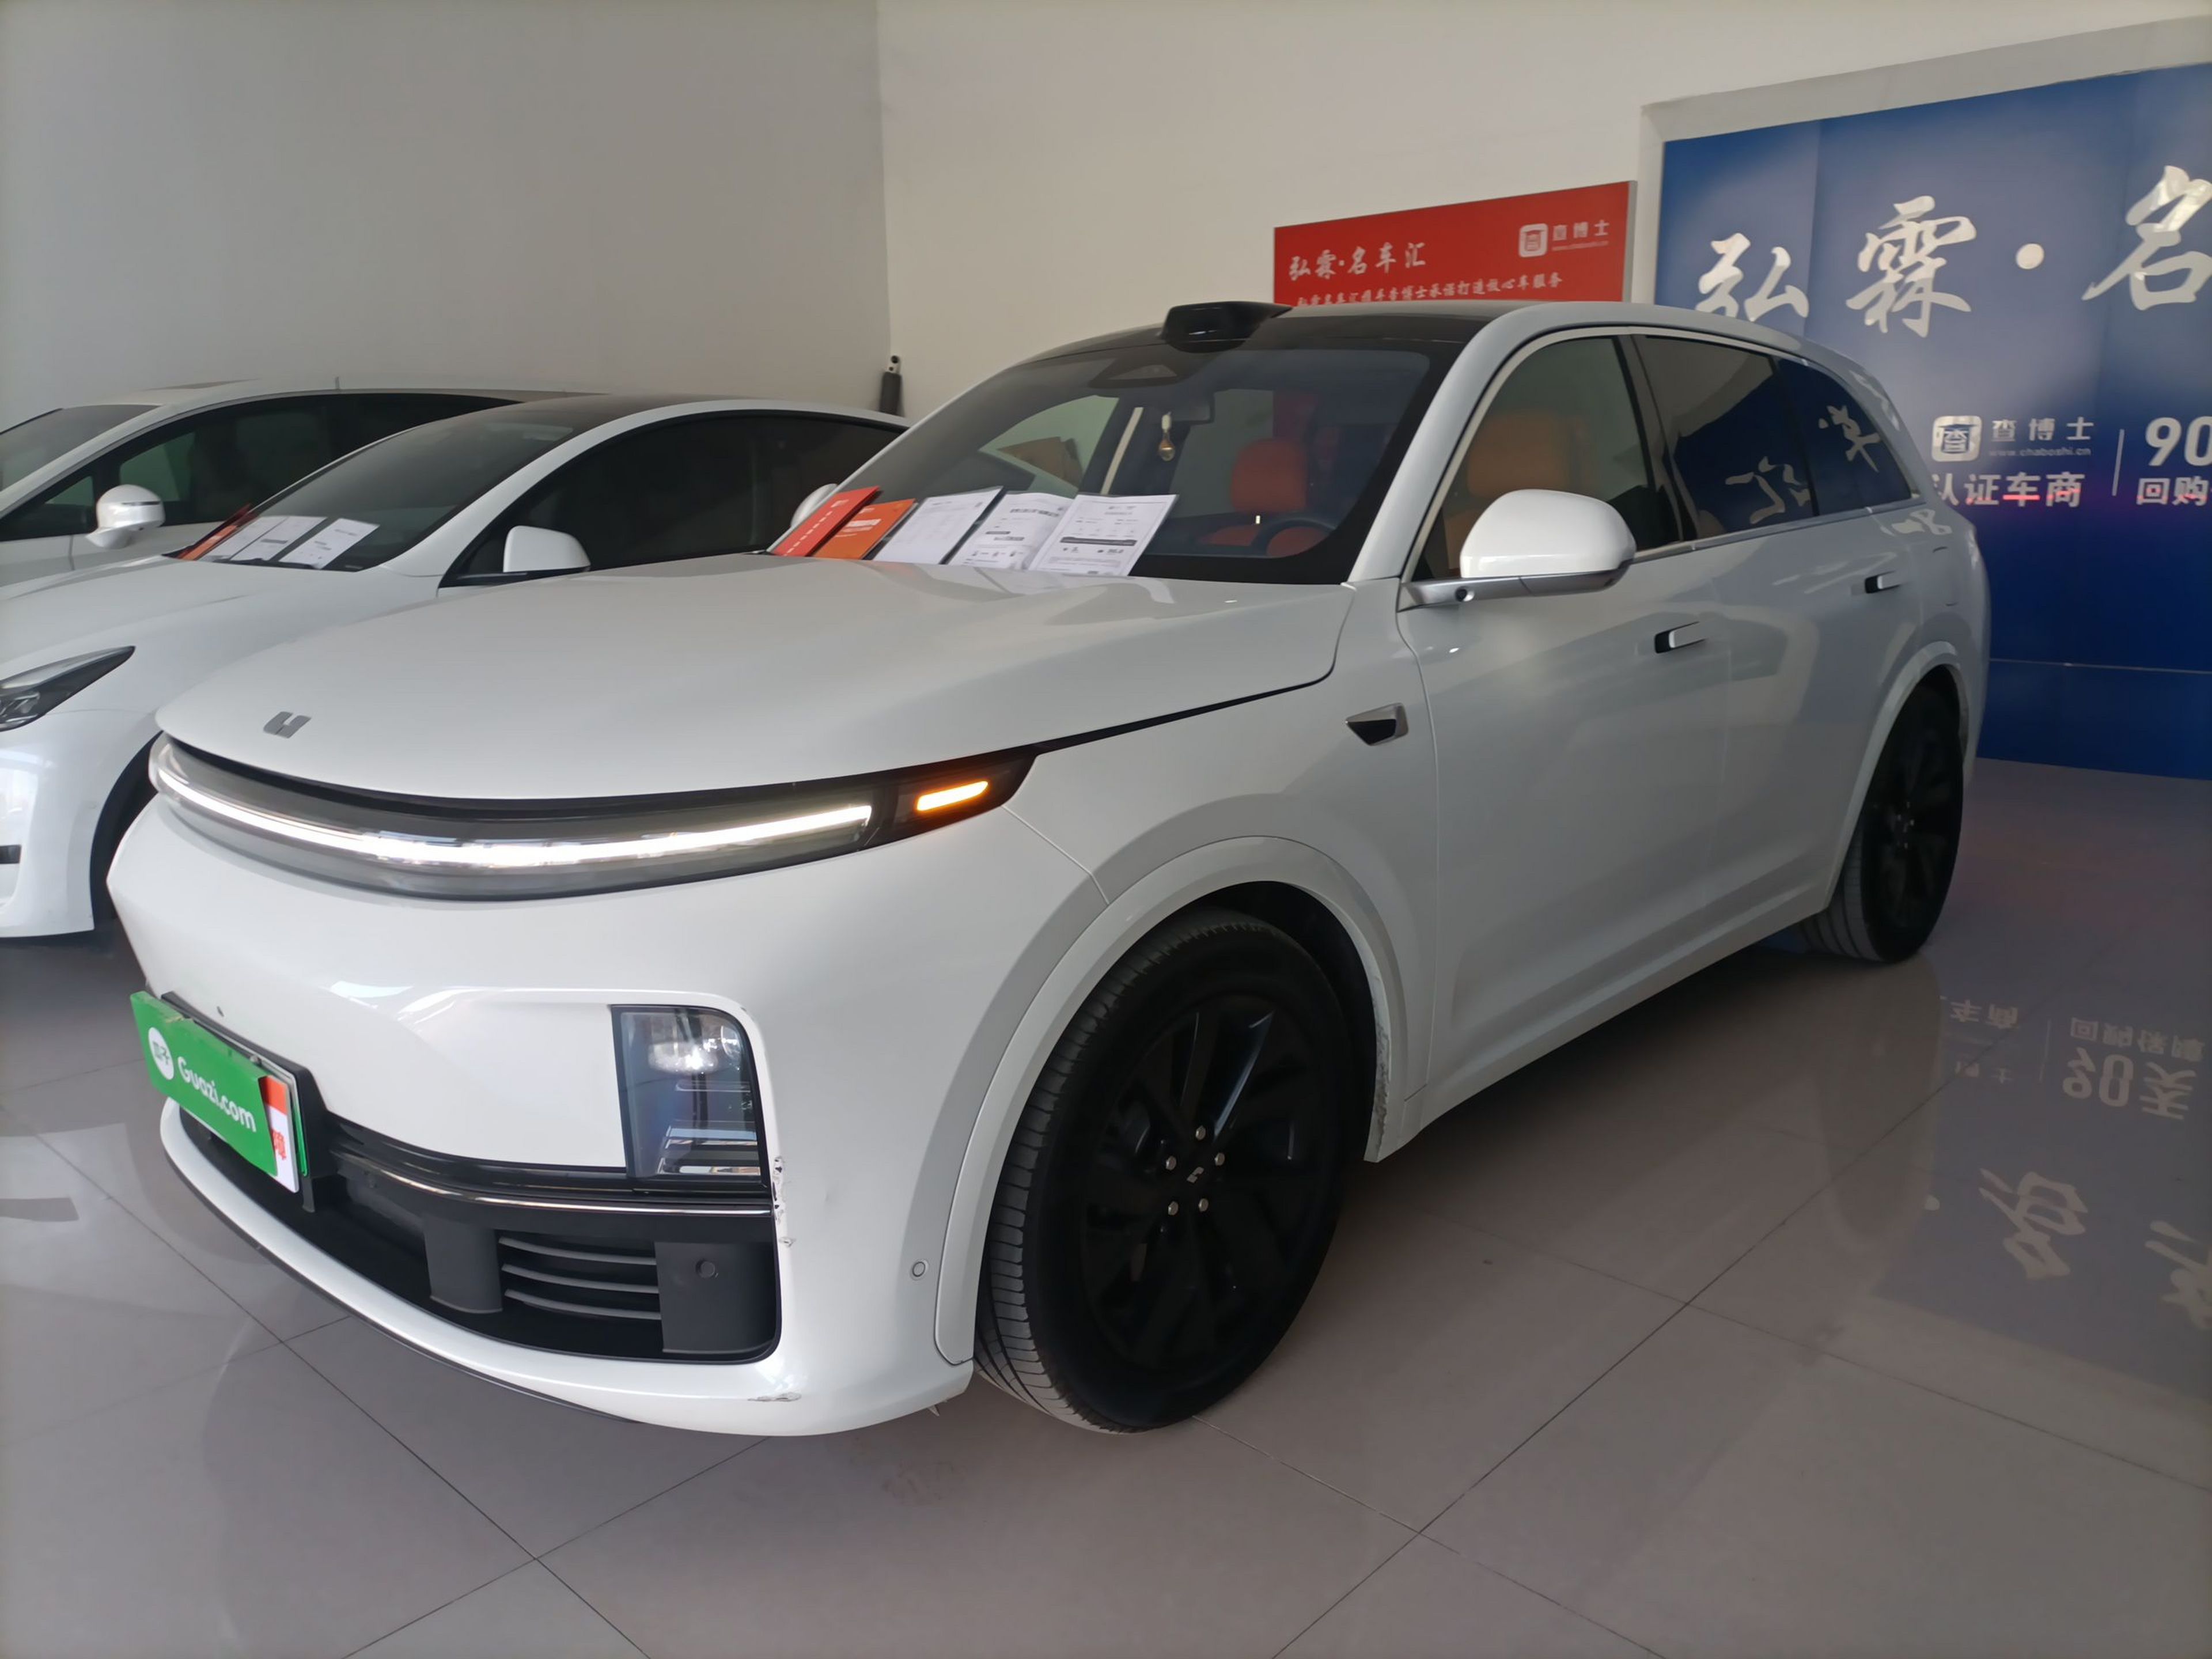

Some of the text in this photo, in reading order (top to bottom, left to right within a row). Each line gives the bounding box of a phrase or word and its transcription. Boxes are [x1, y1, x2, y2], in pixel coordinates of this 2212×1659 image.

[1991, 416, 2094, 442] 查博士
[177, 1056, 257, 1132] Guazi.com
